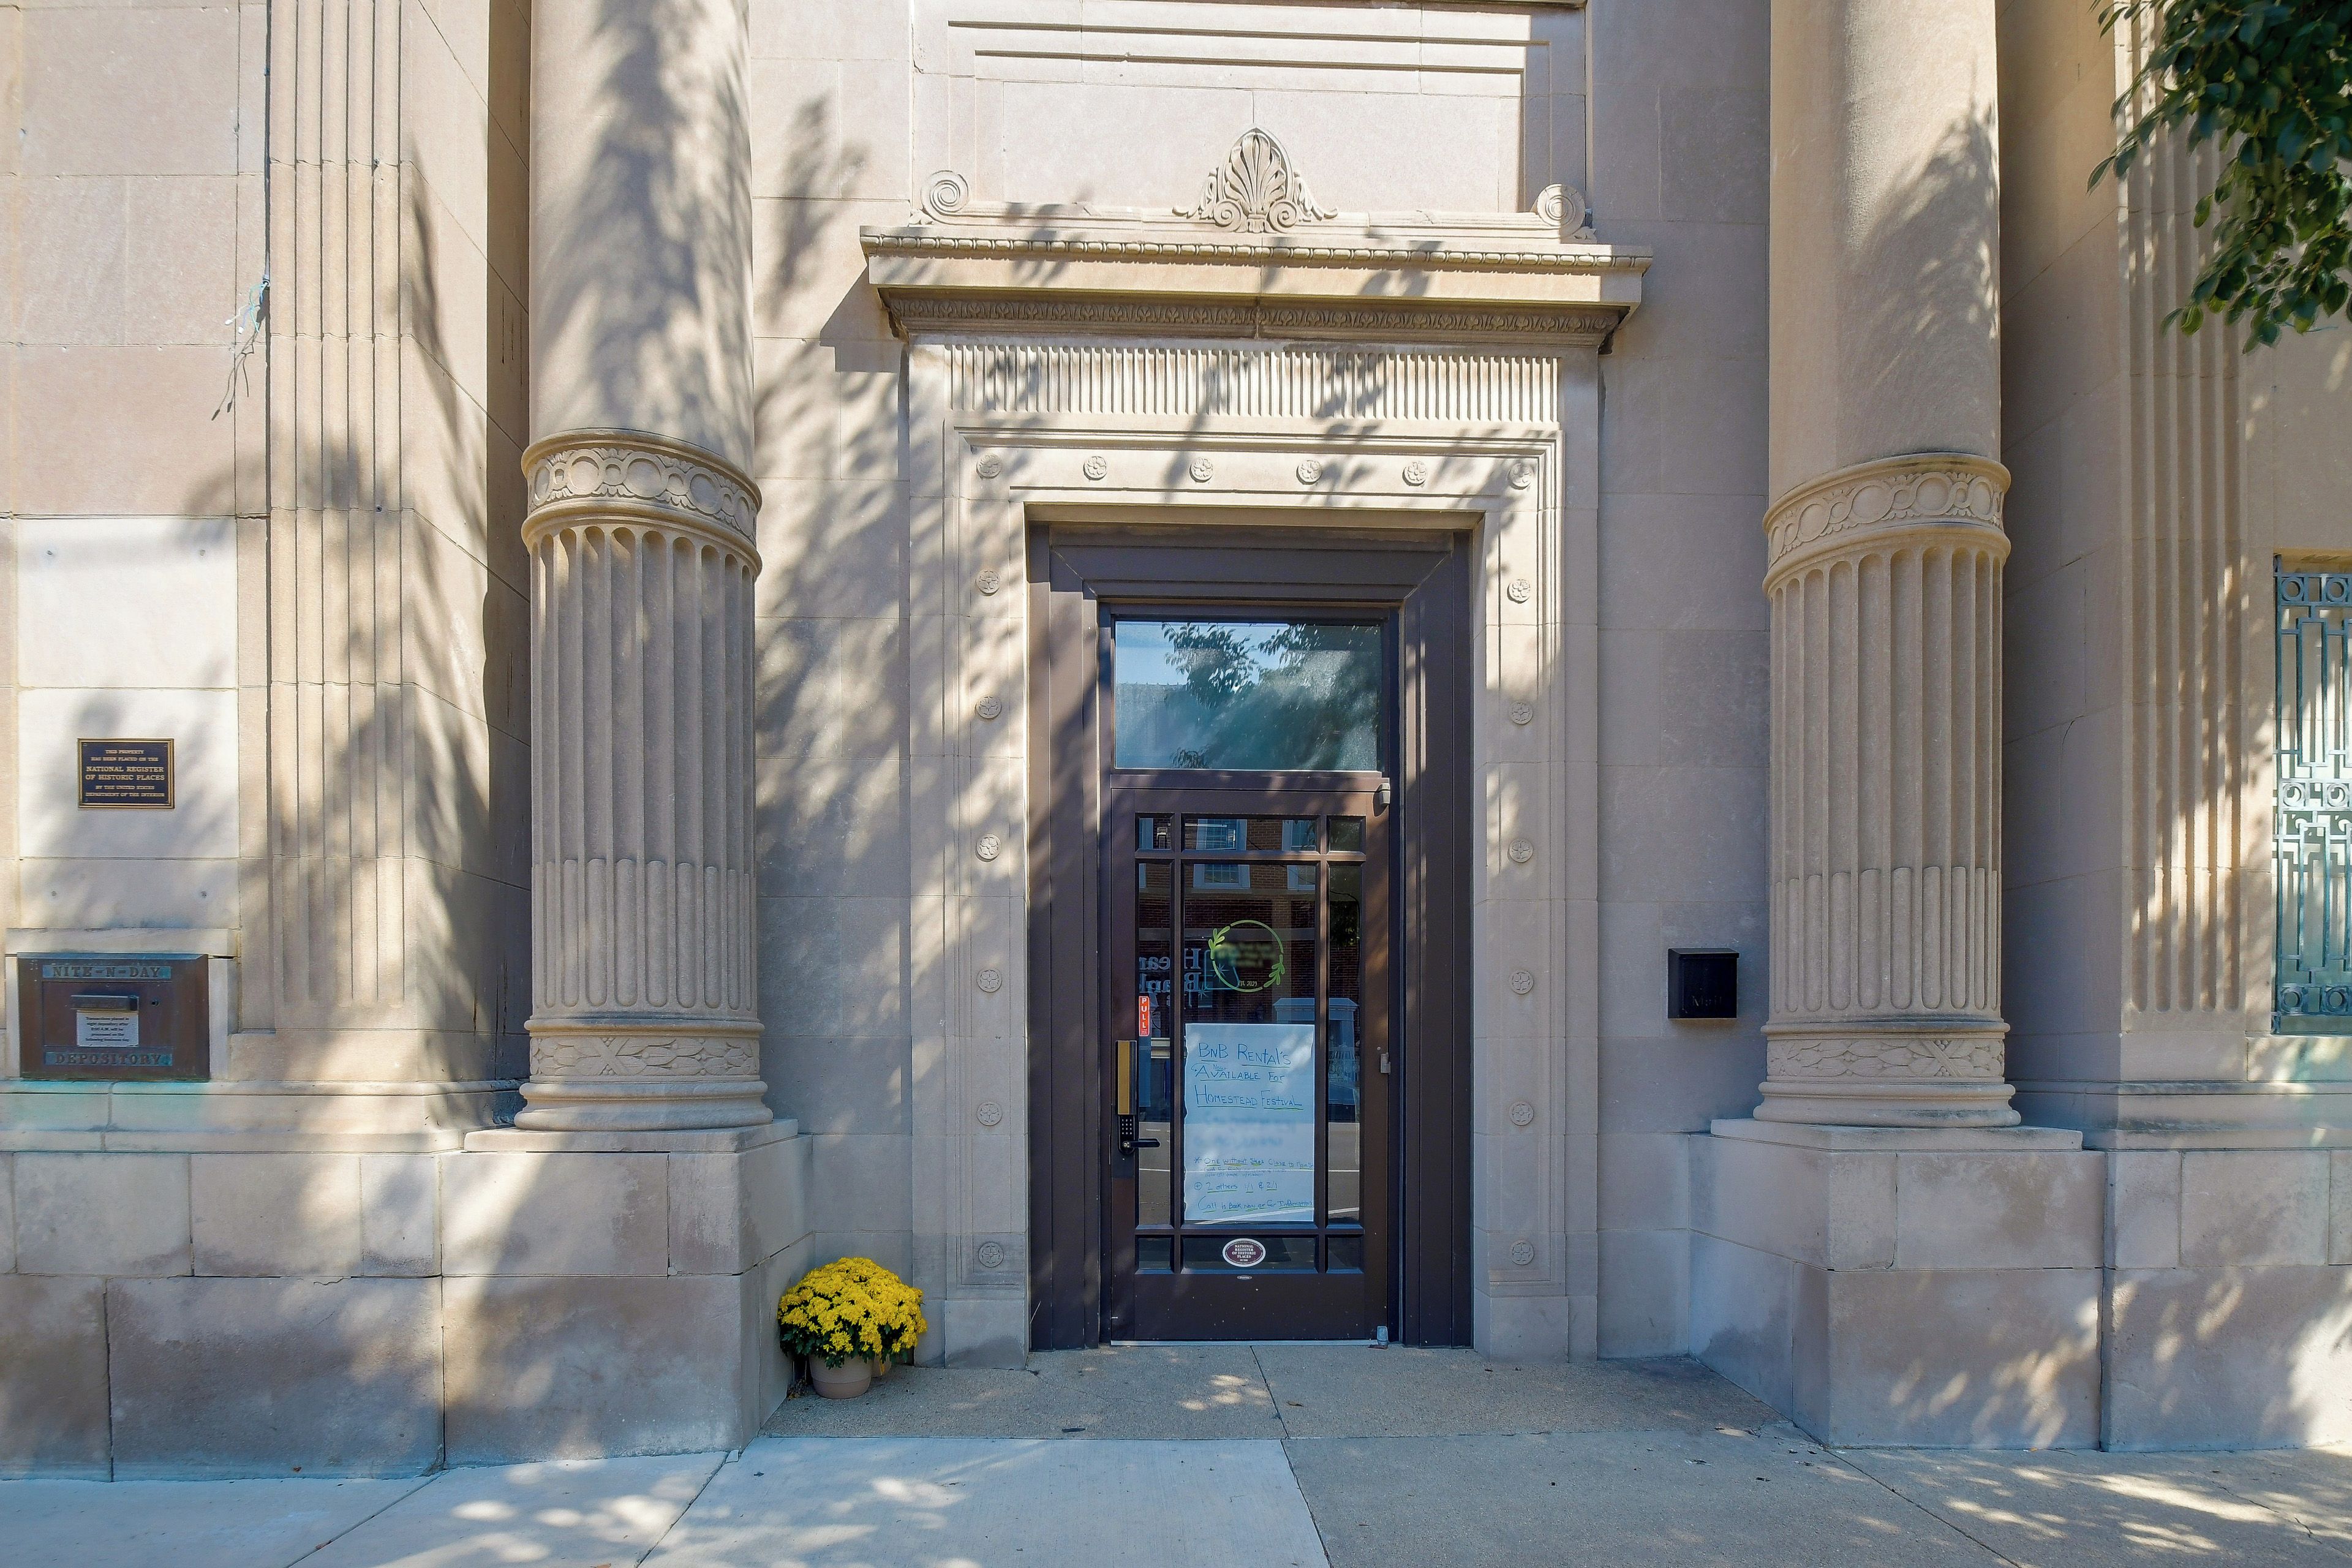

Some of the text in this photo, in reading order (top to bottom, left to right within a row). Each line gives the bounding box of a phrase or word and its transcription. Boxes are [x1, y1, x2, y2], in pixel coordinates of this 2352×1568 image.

[55, 1054, 161, 1065] DEPOSITORY
[1205, 1182, 1212, 1191] 2
[1198, 1196, 1216, 1210] Call
